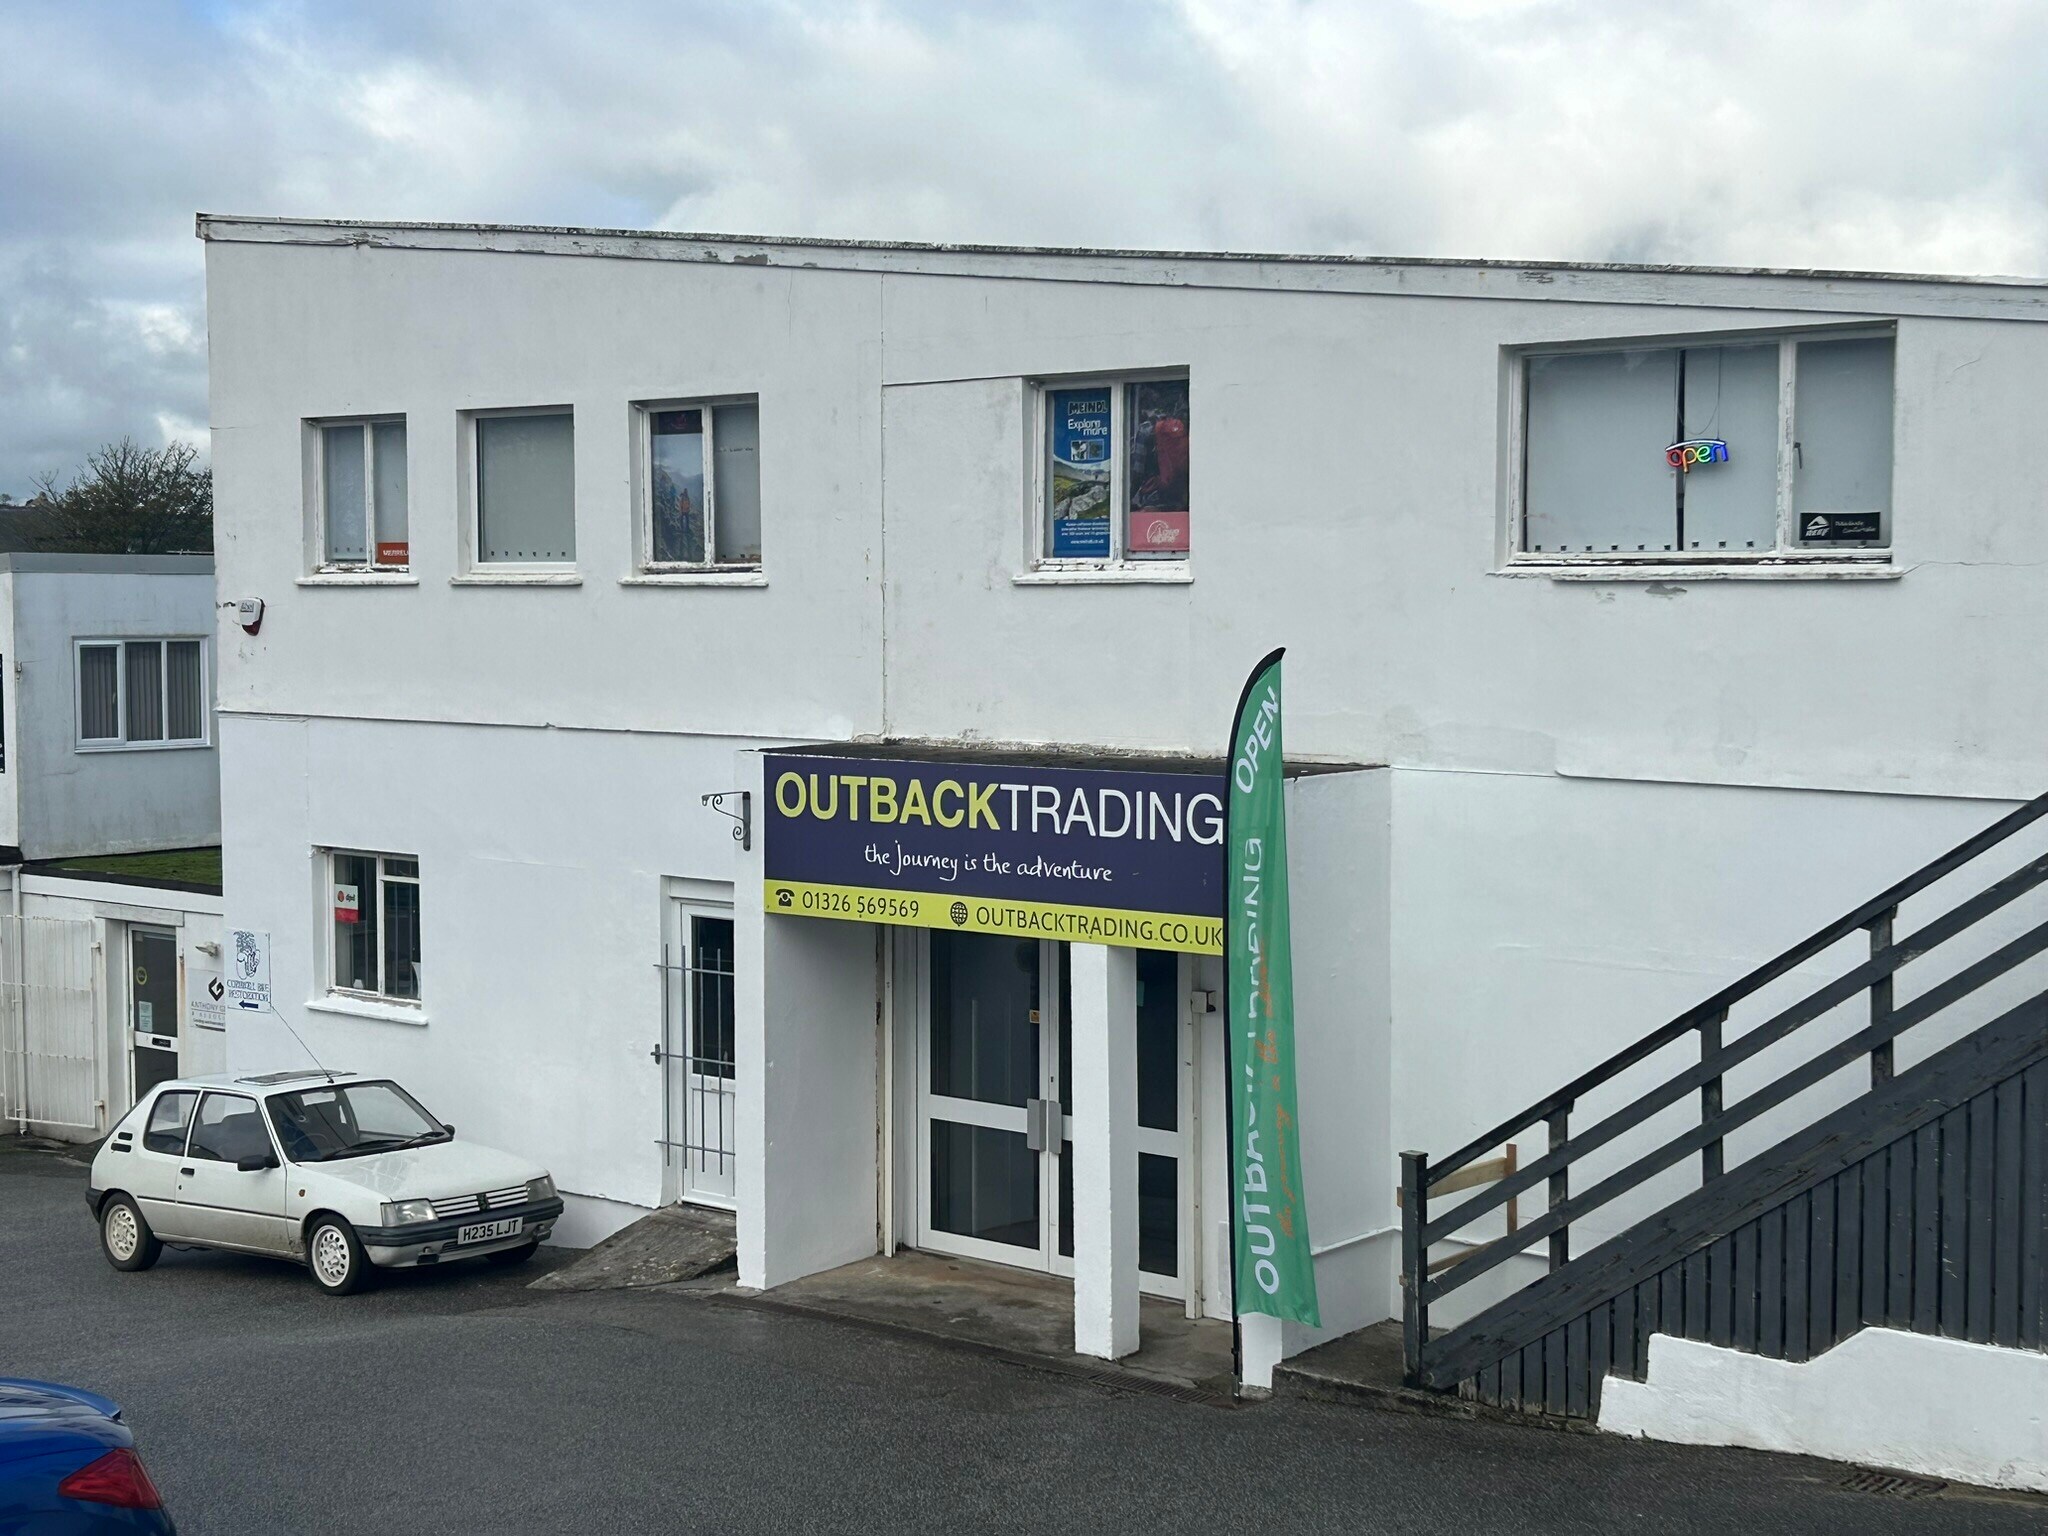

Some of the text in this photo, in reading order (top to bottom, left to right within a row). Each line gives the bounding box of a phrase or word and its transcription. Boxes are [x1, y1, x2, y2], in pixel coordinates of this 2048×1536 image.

[1068, 400, 1108, 416] MEINDL
[1083, 427, 1108, 436] more
[1665, 444, 1729, 474] open
[1235, 685, 1280, 794] OPEN
[865, 843, 890, 865] the
[964, 854, 978, 871] is
[983, 853, 1012, 875] the
[1016, 855, 1113, 882] adventure
[802, 891, 919, 918] 01326 569569
[976, 906, 1223, 947] OUTBACKTRADING.CO.UK
[463, 1219, 519, 1241] H235 LJT
